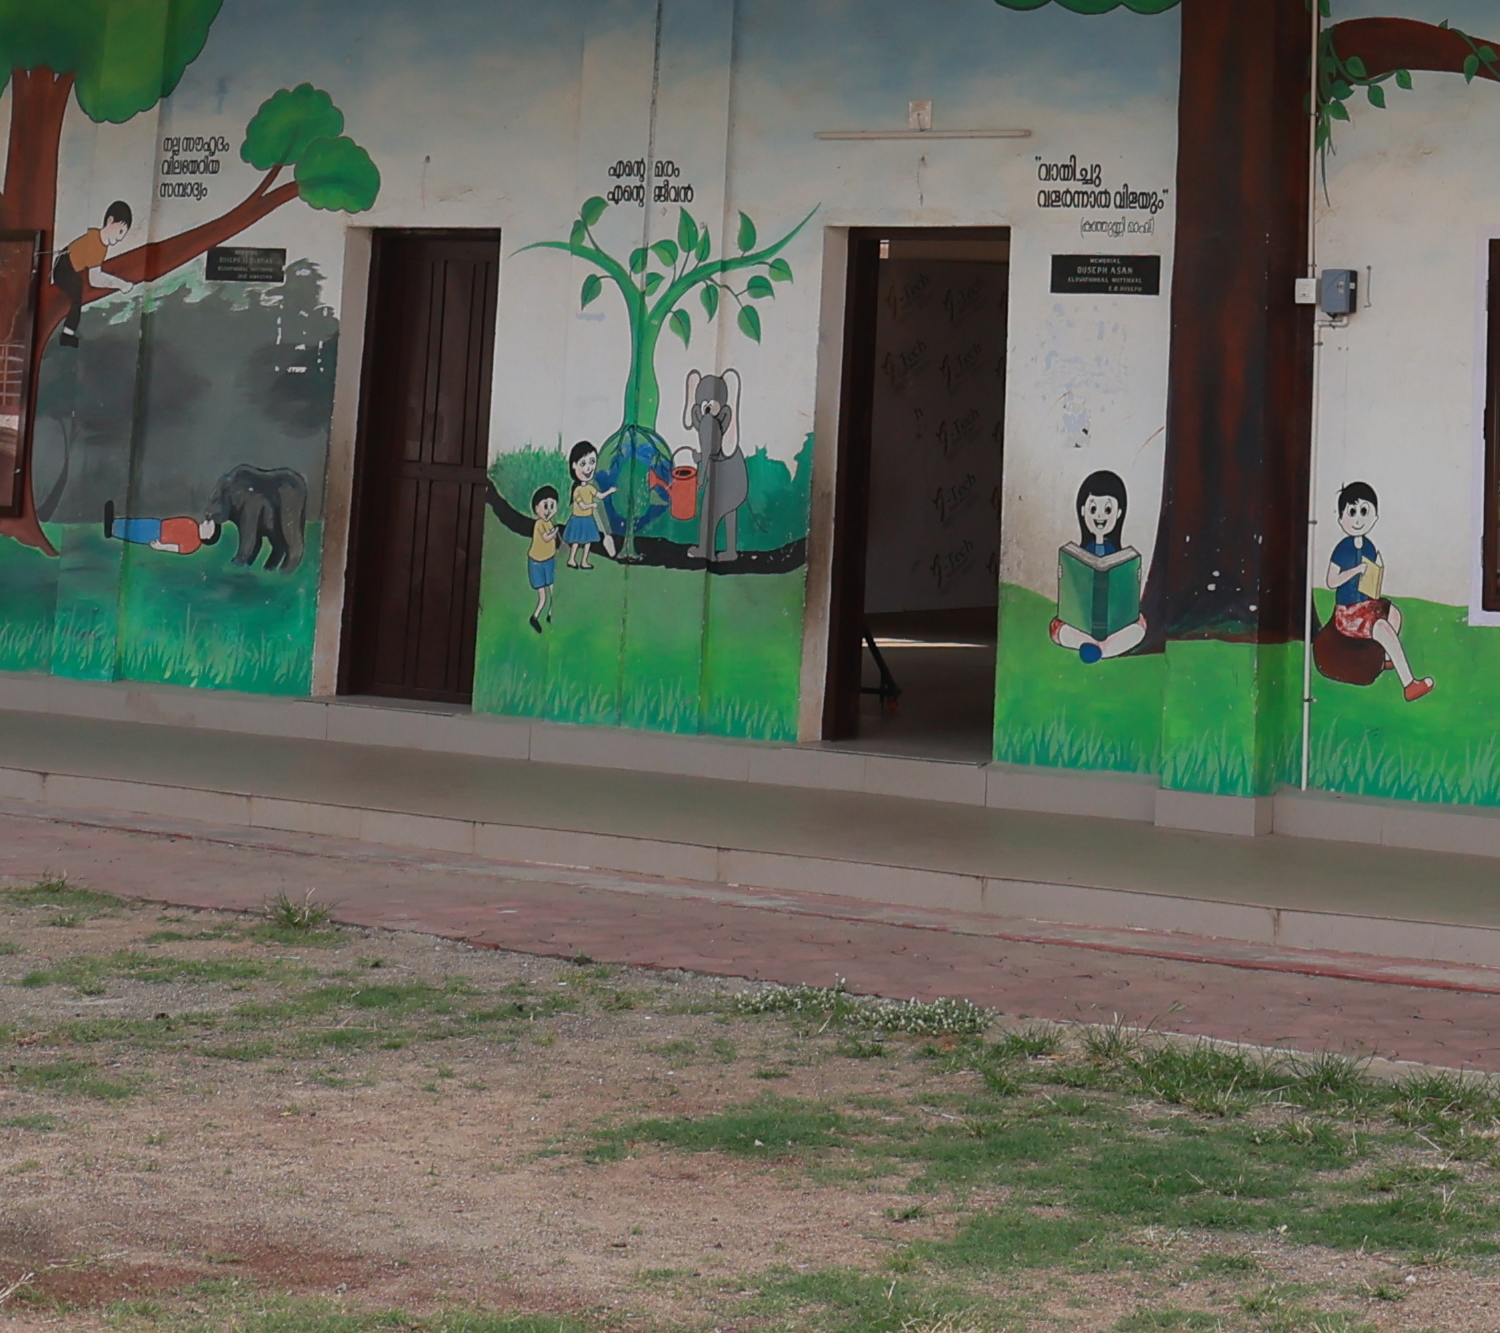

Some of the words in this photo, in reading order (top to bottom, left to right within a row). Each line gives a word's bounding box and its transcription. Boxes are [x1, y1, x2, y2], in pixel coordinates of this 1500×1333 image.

[163, 137, 181, 156] നല്ല
[654, 160, 680, 178] മരം
[1077, 266, 1108, 274] OUSEPH
[1110, 266, 1133, 274] ASAN
